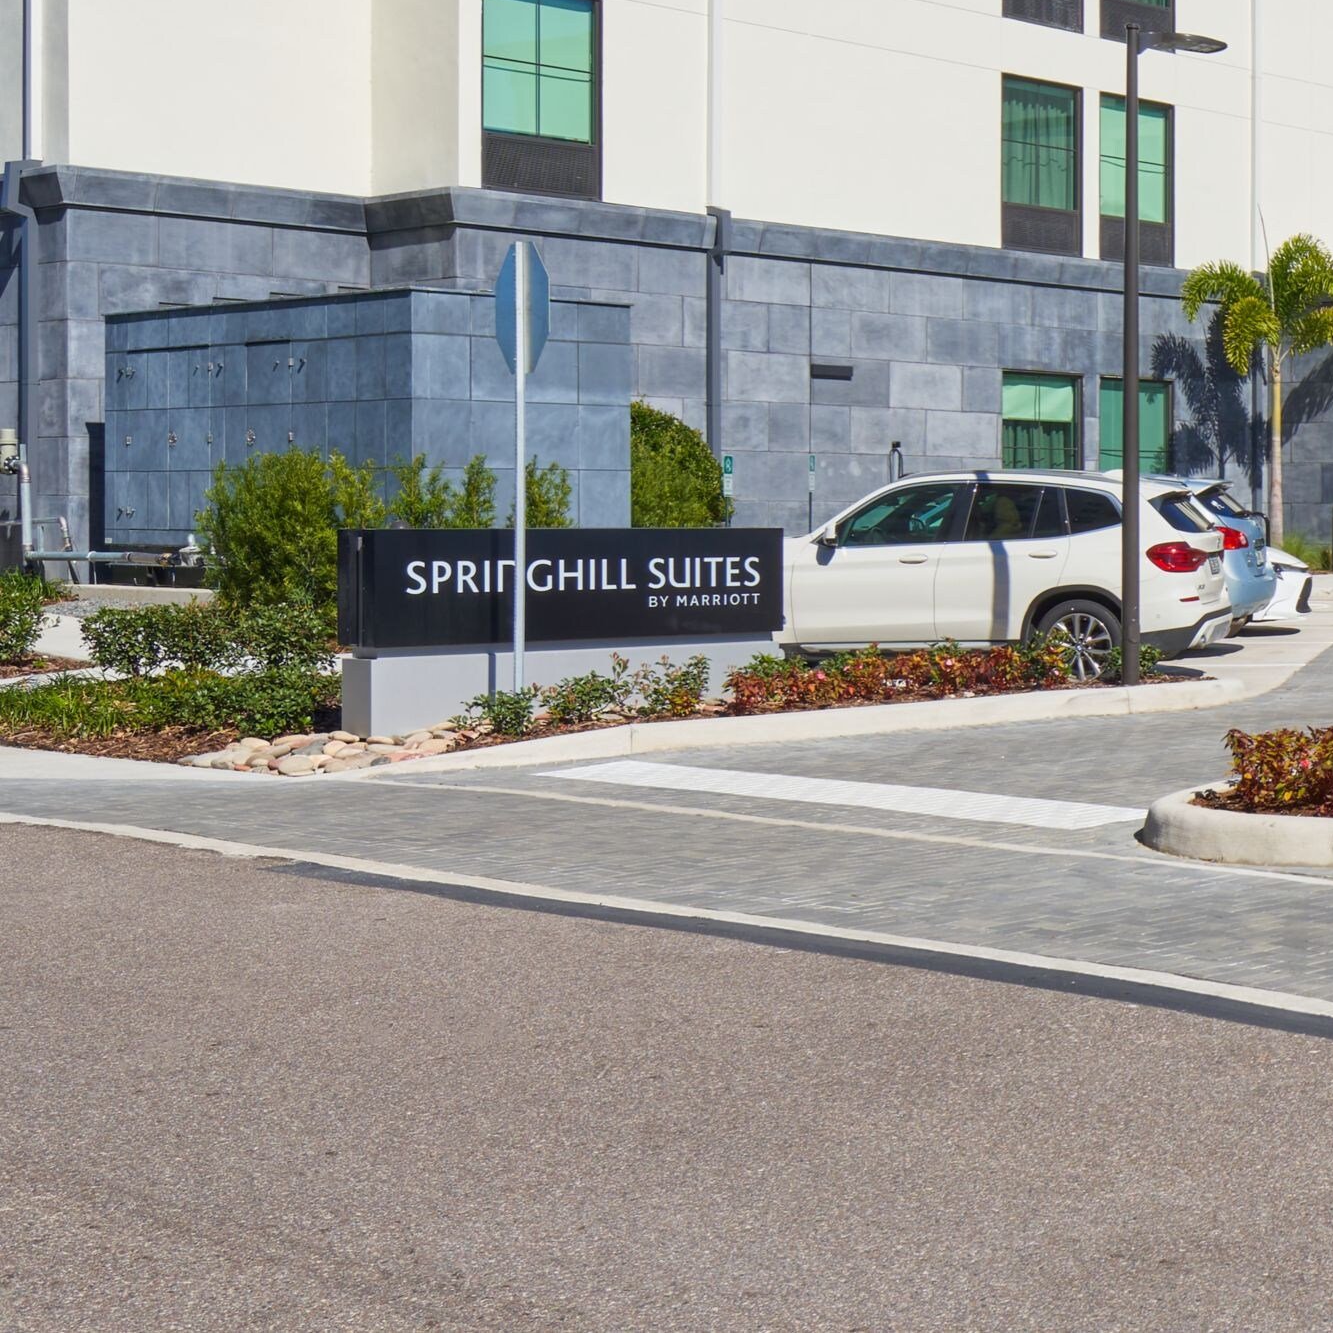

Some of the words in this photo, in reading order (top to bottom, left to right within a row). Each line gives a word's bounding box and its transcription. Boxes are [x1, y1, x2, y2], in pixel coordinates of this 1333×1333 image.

[405, 558, 637, 595] SPRINGHILL
[648, 556, 761, 590] SUITES
[648, 595, 669, 608] BY
[676, 592, 761, 607] MARRIOTT
